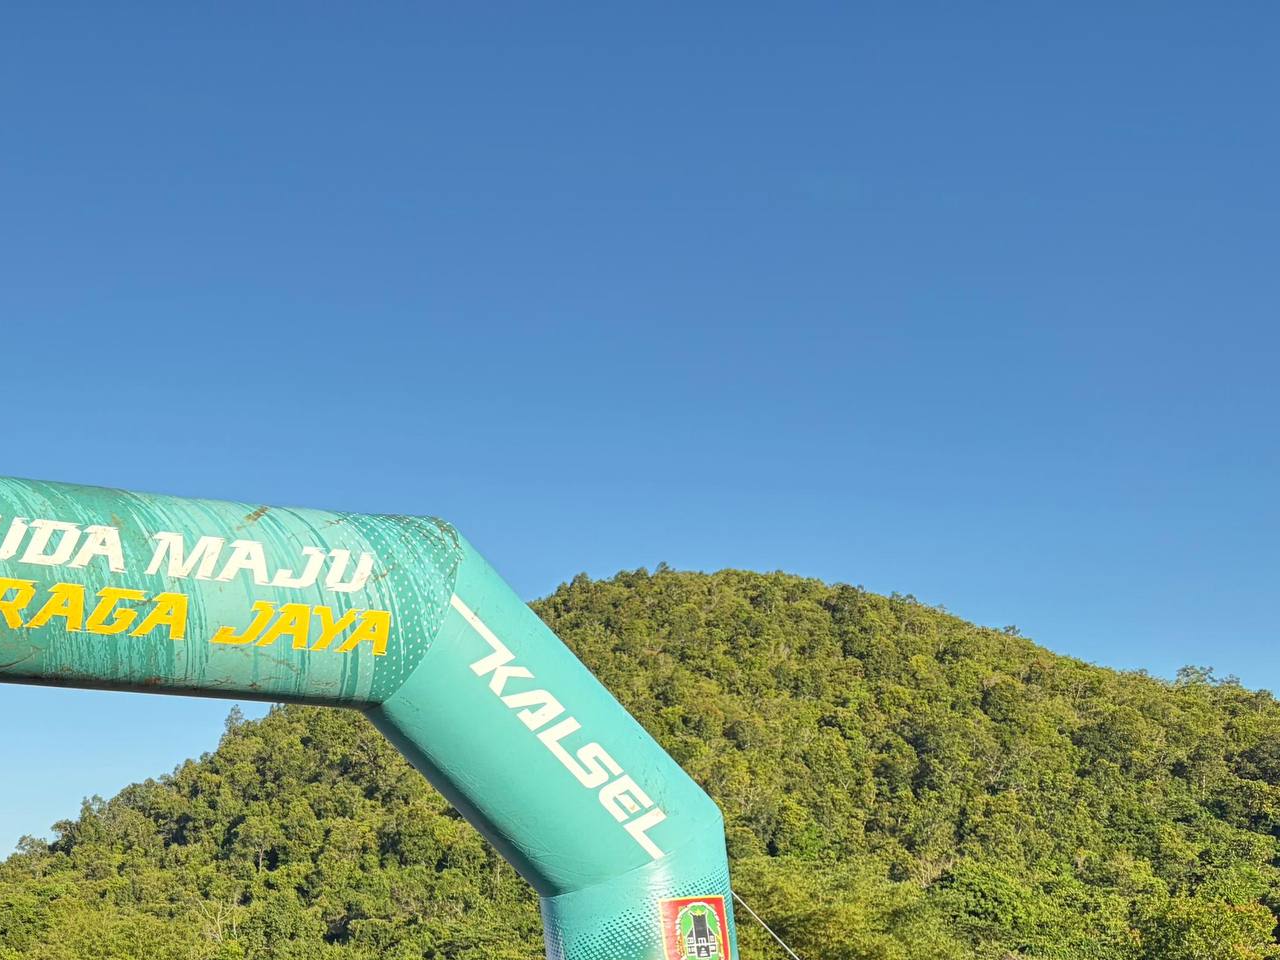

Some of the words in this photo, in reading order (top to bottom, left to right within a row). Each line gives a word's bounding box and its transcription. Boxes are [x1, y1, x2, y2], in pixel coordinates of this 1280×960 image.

[144, 530, 376, 593] MAJU
[209, 600, 392, 656] JAYA
[450, 592, 667, 861] KALSEL
